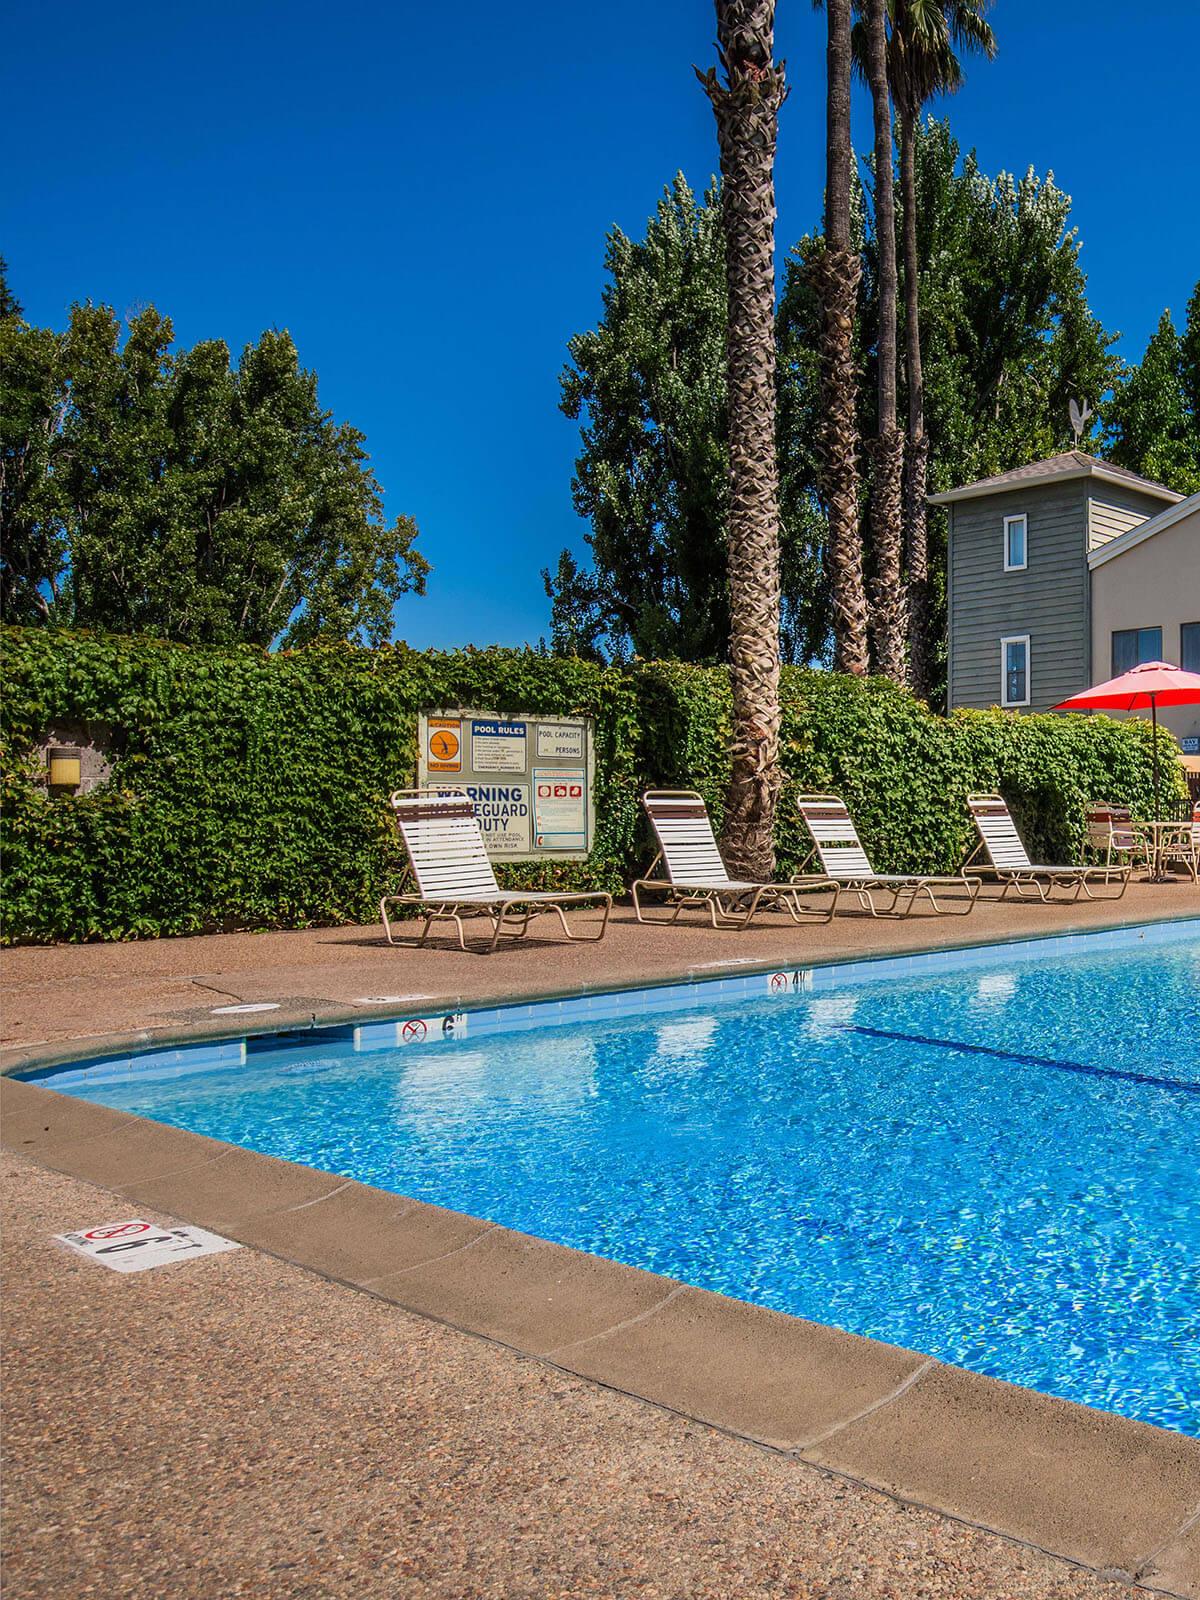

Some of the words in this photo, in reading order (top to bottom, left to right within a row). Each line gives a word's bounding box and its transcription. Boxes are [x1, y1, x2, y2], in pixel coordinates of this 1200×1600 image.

[474, 725, 496, 734] POOL
[498, 726, 525, 735] RULES
[539, 730, 553, 738] POOL
[555, 731, 581, 739] CAPACITY
[555, 746, 580, 754] PERSONS
